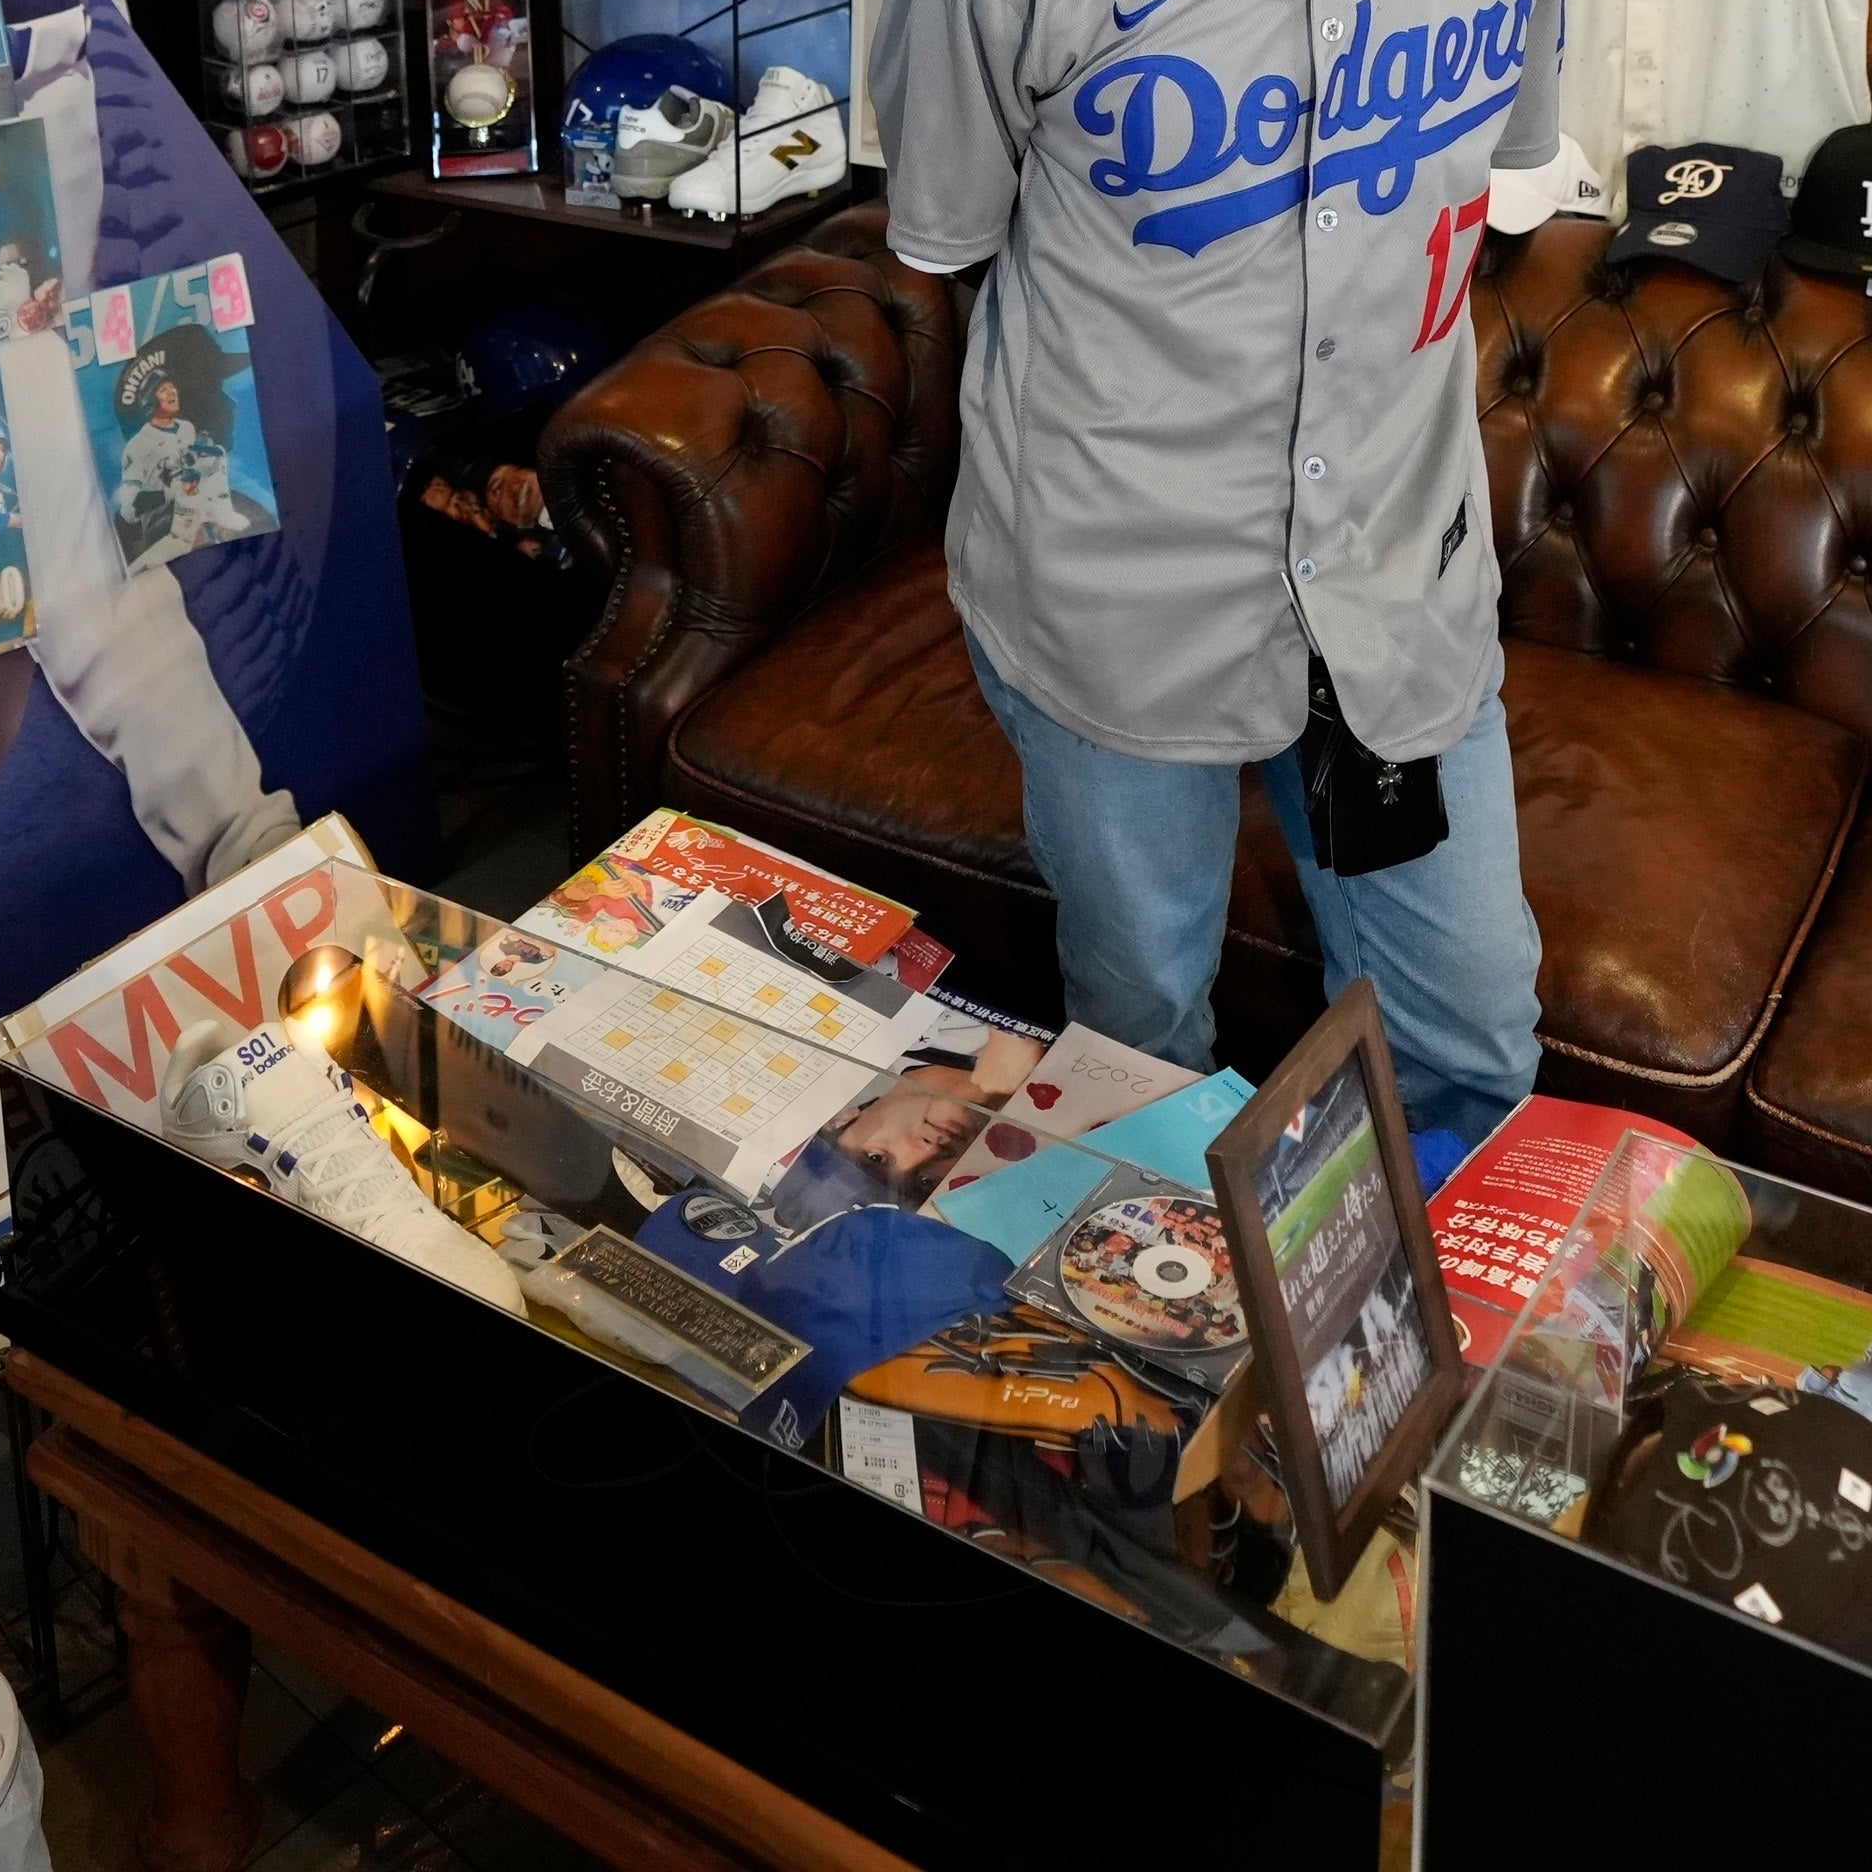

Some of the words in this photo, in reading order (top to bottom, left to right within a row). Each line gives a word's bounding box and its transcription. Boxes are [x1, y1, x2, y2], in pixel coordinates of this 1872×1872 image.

[316, 67, 329, 85] 17
[770, 130, 821, 171] N
[1071, 0, 1534, 259] Dodgers
[1411, 187, 1489, 354] 17
[121, 350, 166, 406] OHTANI
[830, 886, 888, 921] メッセージ
[47, 860, 339, 1111] MVP
[579, 1066, 681, 1141] 時間&お金
[1434, 1253, 1537, 1299] 最高峰の
[1001, 1379, 1080, 1412] i-Pro
